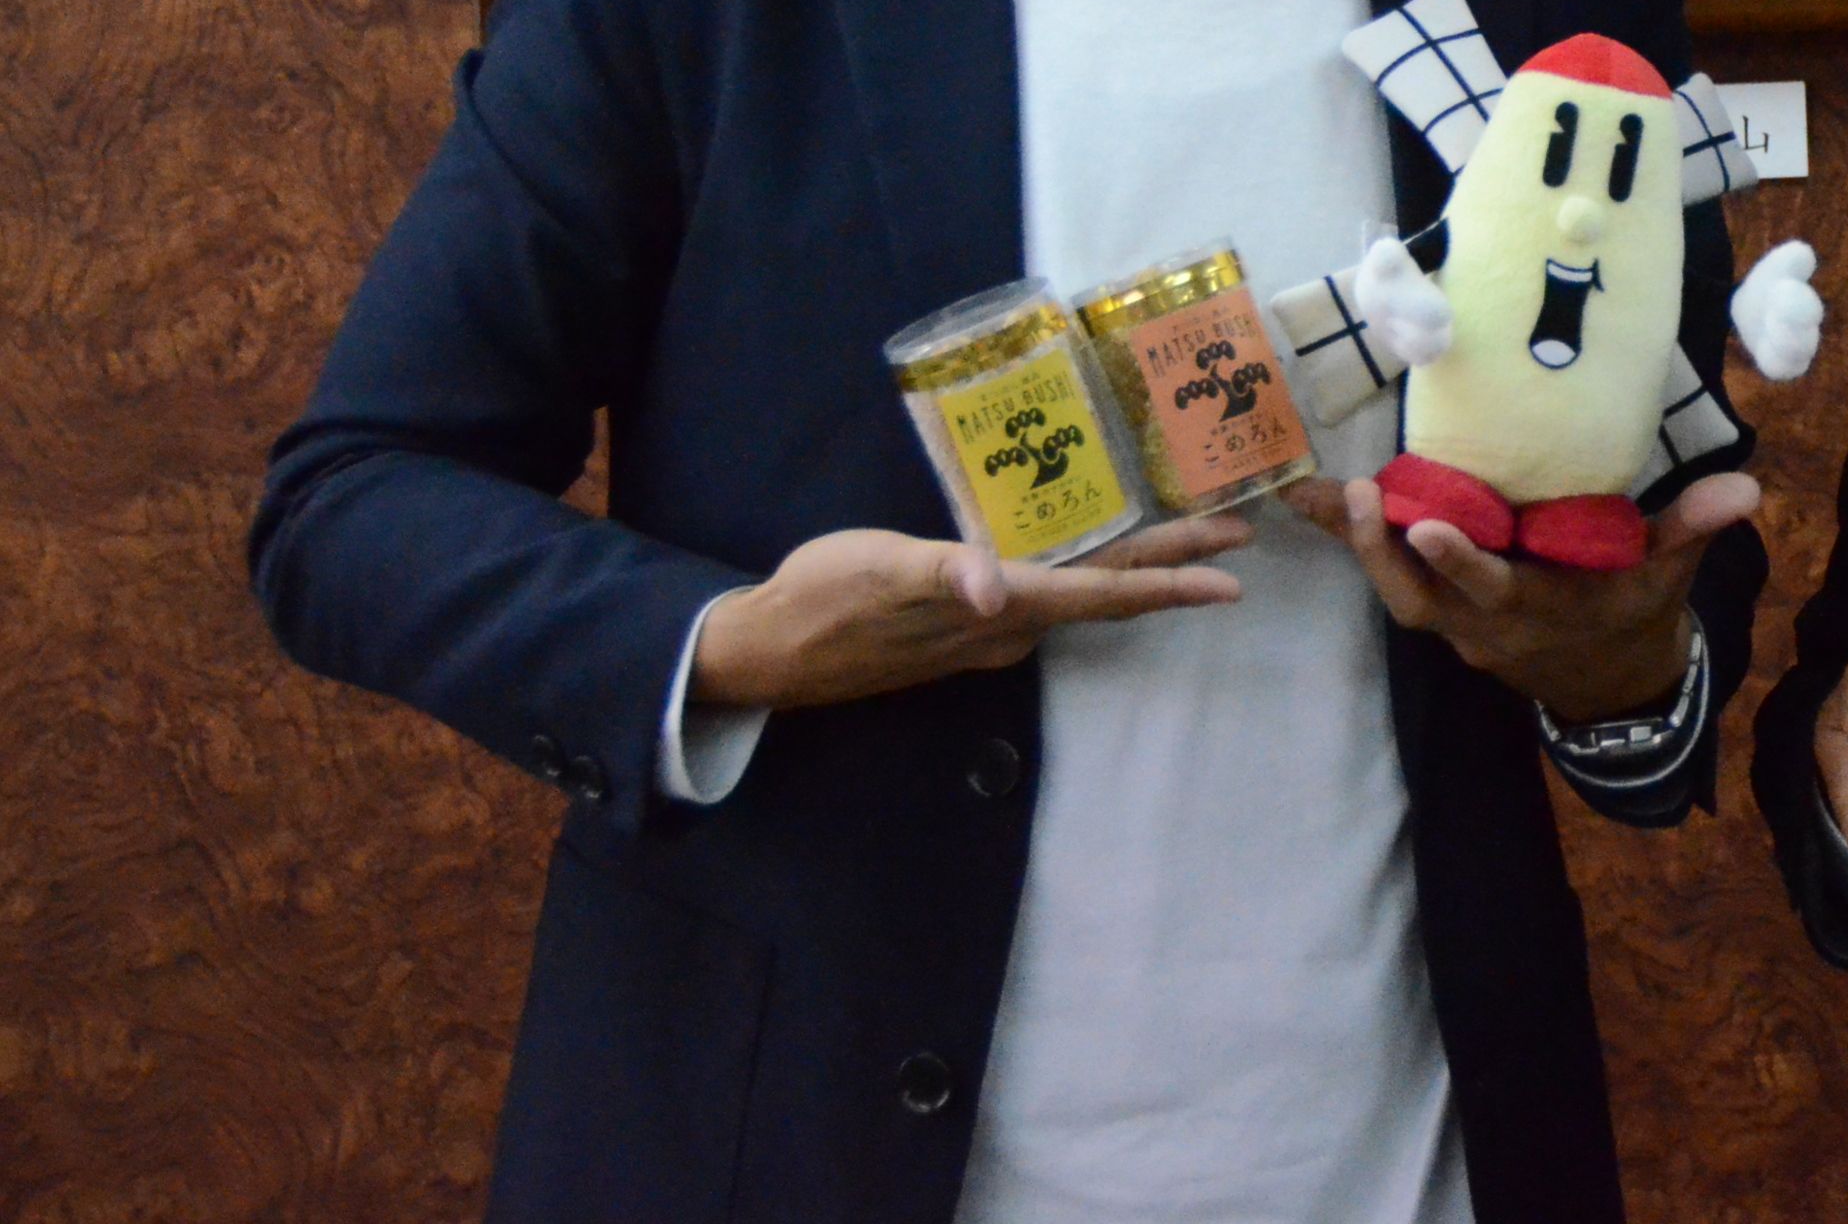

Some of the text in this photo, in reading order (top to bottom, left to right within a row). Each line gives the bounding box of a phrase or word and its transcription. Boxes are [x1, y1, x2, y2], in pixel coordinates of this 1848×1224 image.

[1146, 328, 1206, 377] MATSU
[956, 397, 1015, 444] MATSU
[1021, 370, 1077, 406] BUSHI
[1204, 415, 1287, 463] こめろん
[1013, 480, 1101, 529] こめろん
